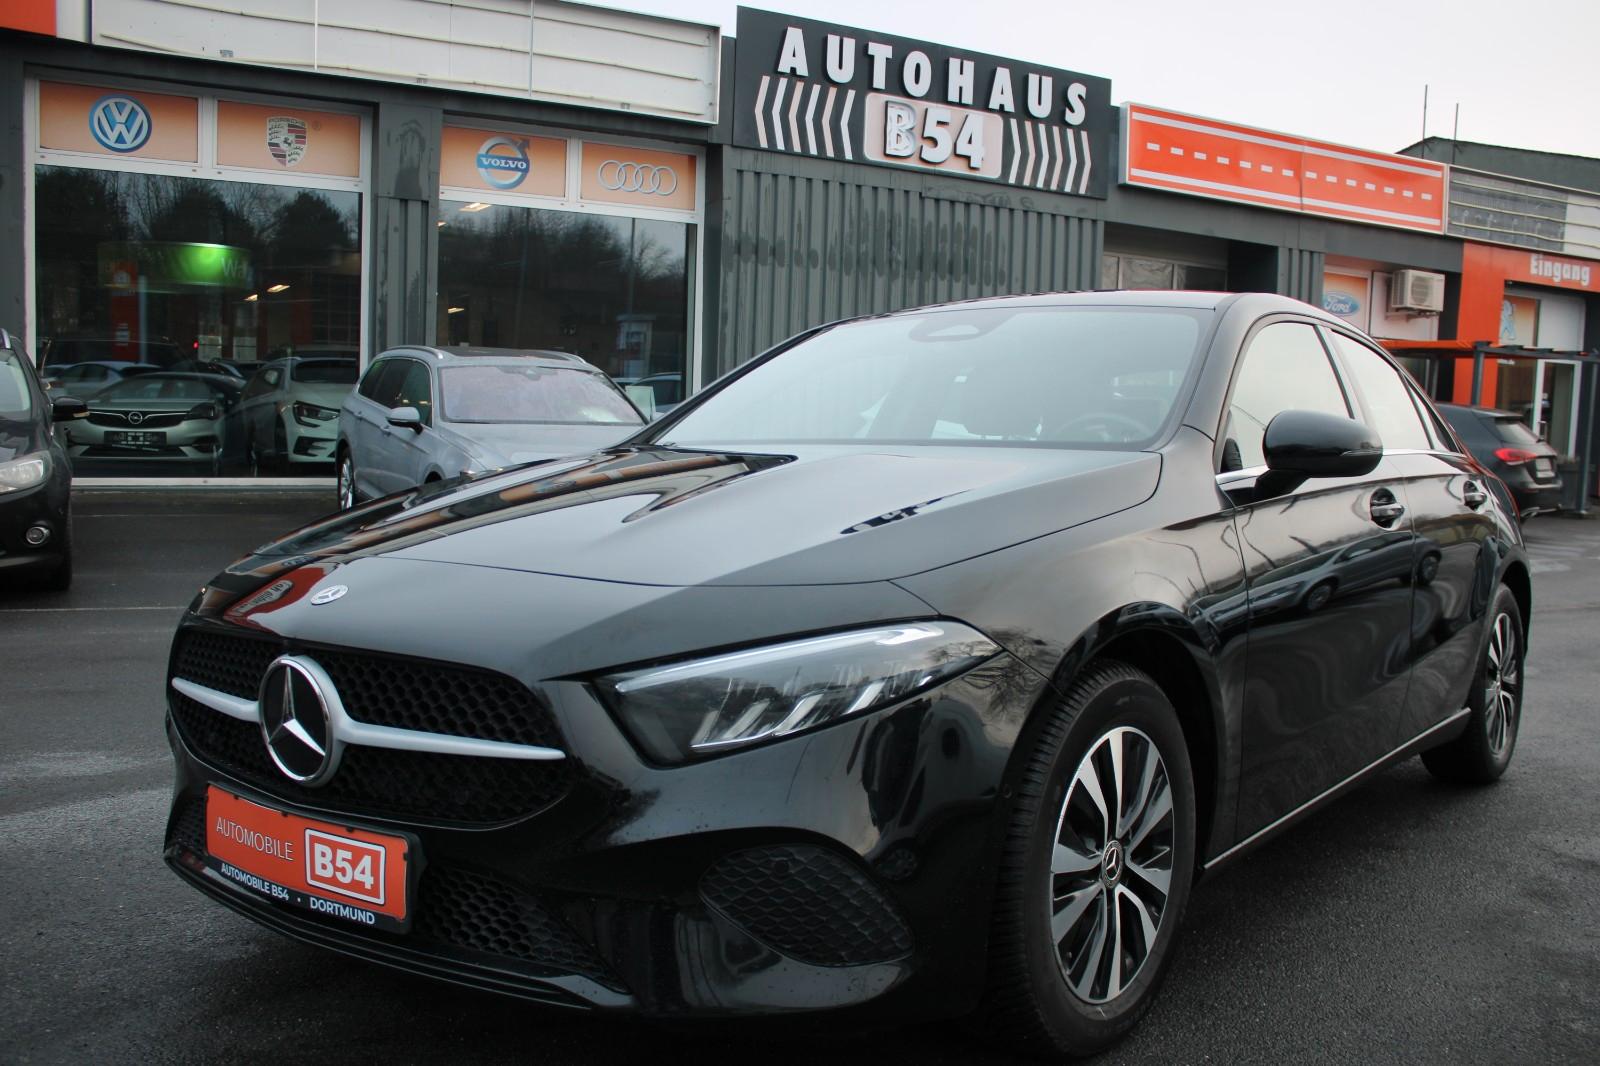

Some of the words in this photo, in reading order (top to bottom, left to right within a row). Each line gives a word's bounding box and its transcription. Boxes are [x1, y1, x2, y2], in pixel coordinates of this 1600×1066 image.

[777, 26, 1087, 126] AUTOHAUS
[885, 101, 984, 169] B54
[480, 157, 527, 169] VOLVO
[1530, 253, 1590, 287] Eingang
[216, 816, 294, 861] AUTOMOBILE
[314, 842, 374, 890] B54
[220, 862, 270, 894] AUTOMOBILE
[272, 883, 289, 901] B54
[309, 896, 376, 925] DORTMUND
